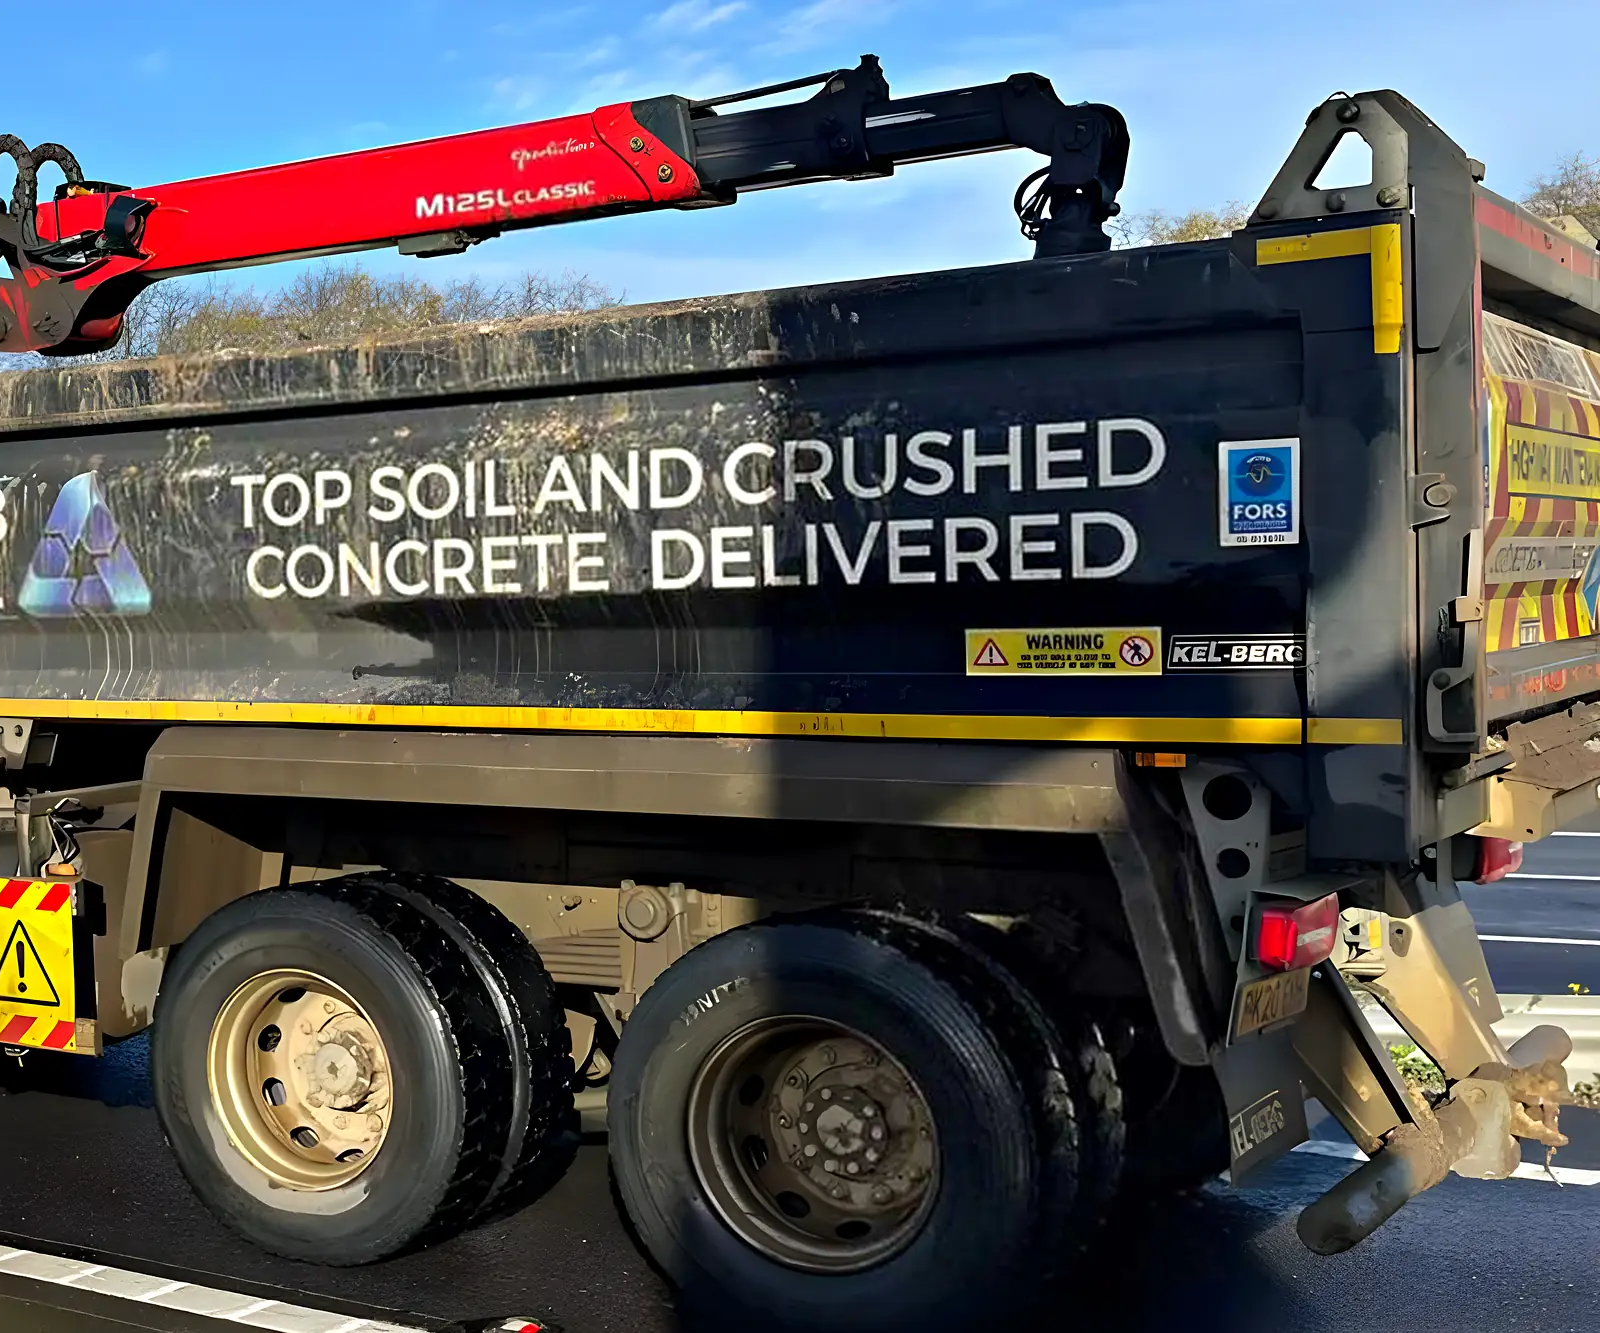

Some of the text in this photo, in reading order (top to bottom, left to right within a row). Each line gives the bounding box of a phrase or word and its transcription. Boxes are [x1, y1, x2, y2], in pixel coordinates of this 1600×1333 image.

[415, 179, 597, 219] M125L CLASSIC
[231, 418, 1167, 528] TOP SOIL AND CRUSHED
[1233, 503, 1287, 520] FORS
[246, 511, 1138, 598] CONCRETE DELIVERED
[1026, 634, 1104, 650] WARNING
[1171, 641, 1303, 663] KEL-BERG
